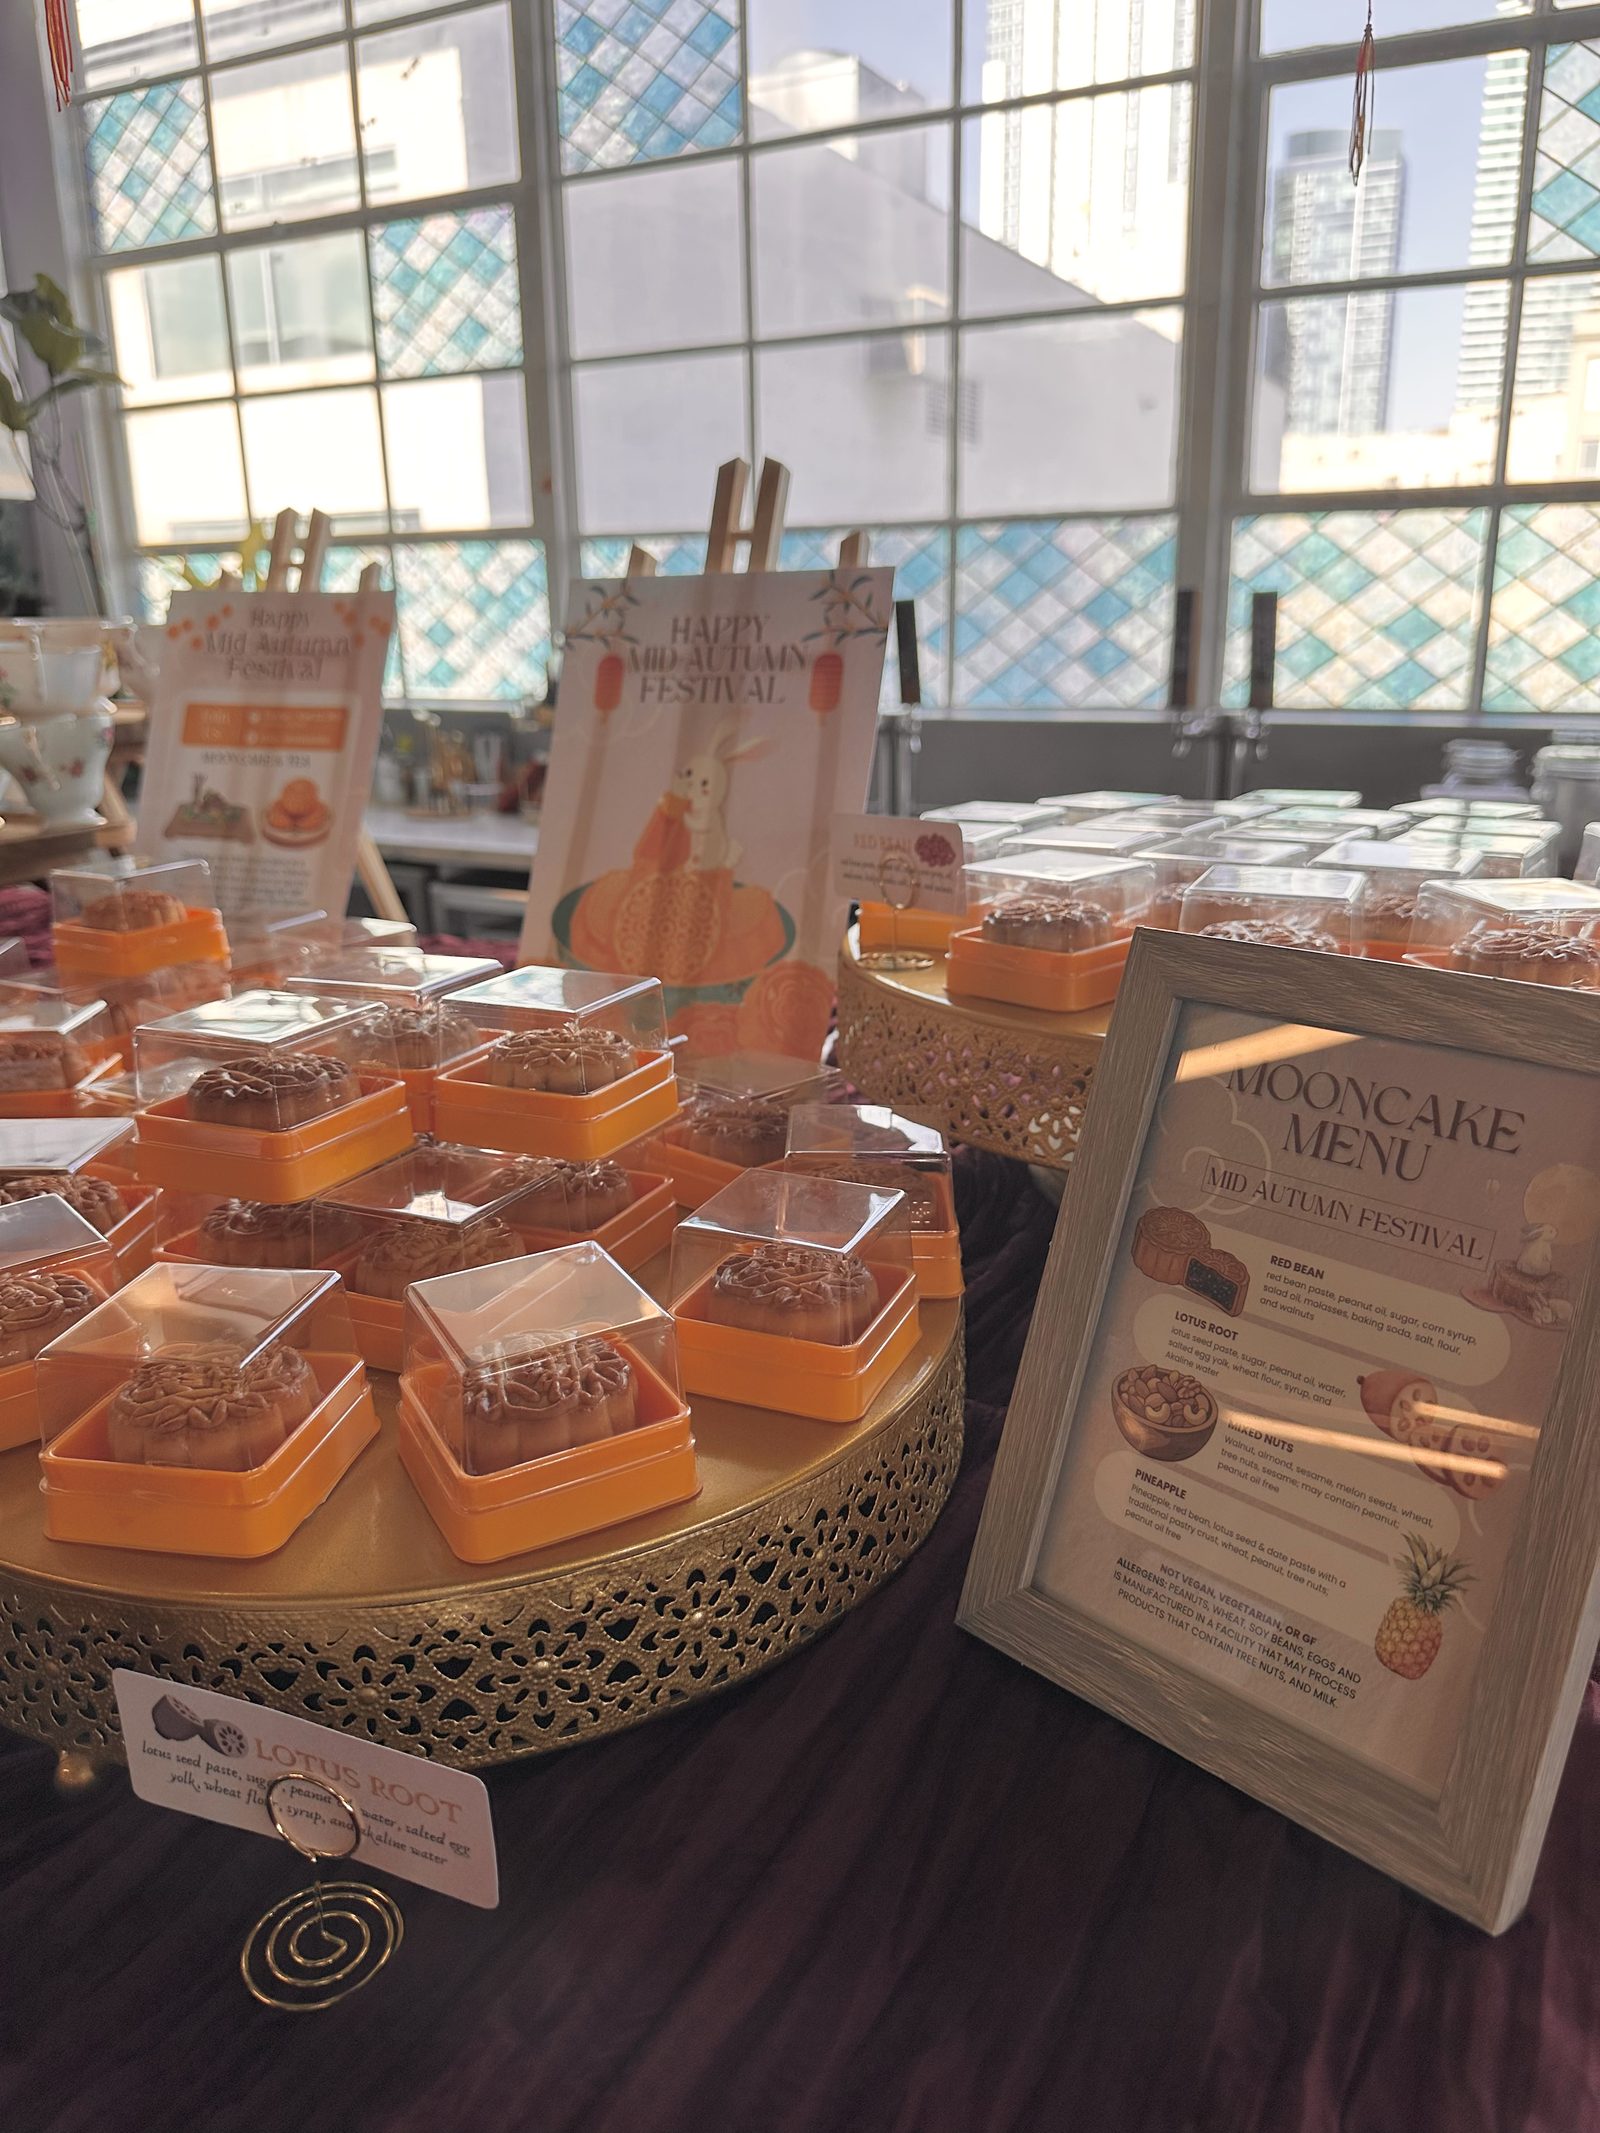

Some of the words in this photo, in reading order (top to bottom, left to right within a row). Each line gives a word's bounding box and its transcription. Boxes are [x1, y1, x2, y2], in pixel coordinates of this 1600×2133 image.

[671, 614, 770, 643] HAPPY
[640, 675, 786, 703] FESTIVAL
[1226, 1062, 1526, 1154] MOONCAKE
[1281, 1112, 1432, 1182] MENU
[1207, 1167, 1247, 1193] MID
[1252, 1179, 1354, 1222] AUTUMN
[1358, 1207, 1484, 1261] FESTIVAL
[1269, 1254, 1292, 1269] RED
[1292, 1262, 1324, 1279] BEAN
[1174, 1310, 1207, 1330] LOTUS
[1207, 1322, 1238, 1341] ROOT
[1259, 1296, 1278, 1309] and
[1279, 1302, 1314, 1320] walnuts
[1262, 1283, 1288, 1298] salad
[1289, 1292, 1302, 1304] oil,
[1303, 1296, 1350, 1319] molasses,
[1350, 1311, 1384, 1332] baking
[1385, 1323, 1413, 1340] soda,
[1414, 1332, 1435, 1347] salt,
[1436, 1338, 1462, 1356] flour,
[1265, 1271, 1282, 1283] red
[1282, 1275, 1306, 1290] bean
[1307, 1284, 1336, 1301] paste,
[1336, 1293, 1373, 1312] peanut
[1373, 1305, 1388, 1317] oil,
[1389, 1310, 1420, 1328] sugar,
[1421, 1320, 1445, 1335] corn
[1446, 1328, 1477, 1346] syrup,
[1167, 1339, 1193, 1354] salted
[1193, 1348, 1211, 1363] egg
[1211, 1354, 1230, 1369] yolk,
[1231, 1362, 1259, 1379] wheat
[1260, 1372, 1282, 1389] flour,
[1283, 1382, 1311, 1400] syrup,
[1312, 1393, 1332, 1406] and
[1170, 1326, 1190, 1340] lotus
[1191, 1334, 1213, 1348] seed
[1212, 1342, 1239, 1359] paste,
[1240, 1353, 1267, 1370] sugar,
[1268, 1363, 1302, 1382] peanut
[1302, 1375, 1315, 1387] oil,
[1316, 1380, 1346, 1399] water,
[1195, 1362, 1219, 1377] water
[1216, 1460, 1248, 1481] peanut
[1249, 1474, 1261, 1485] oil
[1261, 1478, 1280, 1493] free
[1263, 1433, 1294, 1453] NUTS
[1134, 1468, 1187, 1500] PINEAPPLE
[1220, 1447, 1238, 1462] tree
[1238, 1456, 1260, 1472] nuts,
[1300, 1481, 1323, 1499] may
[1323, 1490, 1361, 1513] contain
[1223, 1434, 1256, 1456] Walnut,
[1257, 1449, 1294, 1471] almond,
[1295, 1464, 1334, 1489] sesame,
[1335, 1481, 1367, 1501] melon
[1400, 1507, 1434, 1529] wheat,
[1124, 1507, 1153, 1528] peanut
[1153, 1522, 1164, 1533] oil
[1164, 1526, 1181, 1541] free
[1127, 1495, 1169, 1521] traditional
[1168, 1515, 1196, 1536] pastry
[1196, 1527, 1220, 1547] crust,
[1220, 1539, 1250, 1560] wheat,
[1249, 1552, 1285, 1577] peanut,
[1286, 1569, 1305, 1585] tree
[1130, 1482, 1172, 1510] Pineapple,
[1172, 1503, 1187, 1517] red
[1187, 1509, 1212, 1529] bean,
[1212, 1520, 1234, 1538] lotus
[1234, 1531, 1257, 1548] seed
[1257, 1541, 1266, 1552] &
[1266, 1545, 1289, 1563] date
[1288, 1556, 1316, 1576] paste
[1317, 1567, 1338, 1585] with
[1338, 1579, 1346, 1589] a
[1112, 1569, 1122, 1582] IS
[1122, 1574, 1194, 1618] MANUFACTURED
[1194, 1611, 1205, 1624] IN
[1206, 1616, 1214, 1629] A
[1214, 1621, 1255, 1649] FACILITY
[1257, 1642, 1283, 1663] THAT
[1283, 1655, 1307, 1675] MAY
[1307, 1667, 1356, 1700] PROCESS
[1116, 1556, 1168, 1590] ALLERGENS:
[1167, 1581, 1210, 1612] PEANUTS,
[1248, 1621, 1270, 1640] SOY
[1269, 1631, 1305, 1659] BEANS,
[1306, 1649, 1336, 1673] EGGS
[1336, 1665, 1361, 1685] AND
[1117, 1587, 1165, 1620] PRODUCTS
[1166, 1612, 1190, 1632] THAT
[1190, 1625, 1234, 1655] CONTAIN
[1235, 1647, 1257, 1668] TREE
[1258, 1659, 1287, 1683] NUTS,
[1288, 1675, 1311, 1694] AND
[1159, 1563, 1181, 1581] NOT
[1181, 1573, 1216, 1599] VEGAN,
[1218, 1591, 1283, 1632] VEGETARIAN,
[1284, 1624, 1301, 1640] OR
[1301, 1632, 1317, 1647] GF
[140, 1738, 171, 1760] lotus
[174, 1750, 202, 1769] seed
[203, 1760, 242, 1783] paste,
[287, 1782, 334, 1811] peanut
[359, 1807, 402, 1832] water,
[404, 1821, 446, 1845] salted
[449, 1840, 471, 1859] egg
[168, 1767, 201, 1793] yolk,
[202, 1776, 241, 1800] wheat
[285, 1801, 327, 1828] syrup,
[408, 1845, 448, 1865] water
[254, 1738, 361, 1789] LOTUS
[371, 1775, 462, 1823] ROOT
